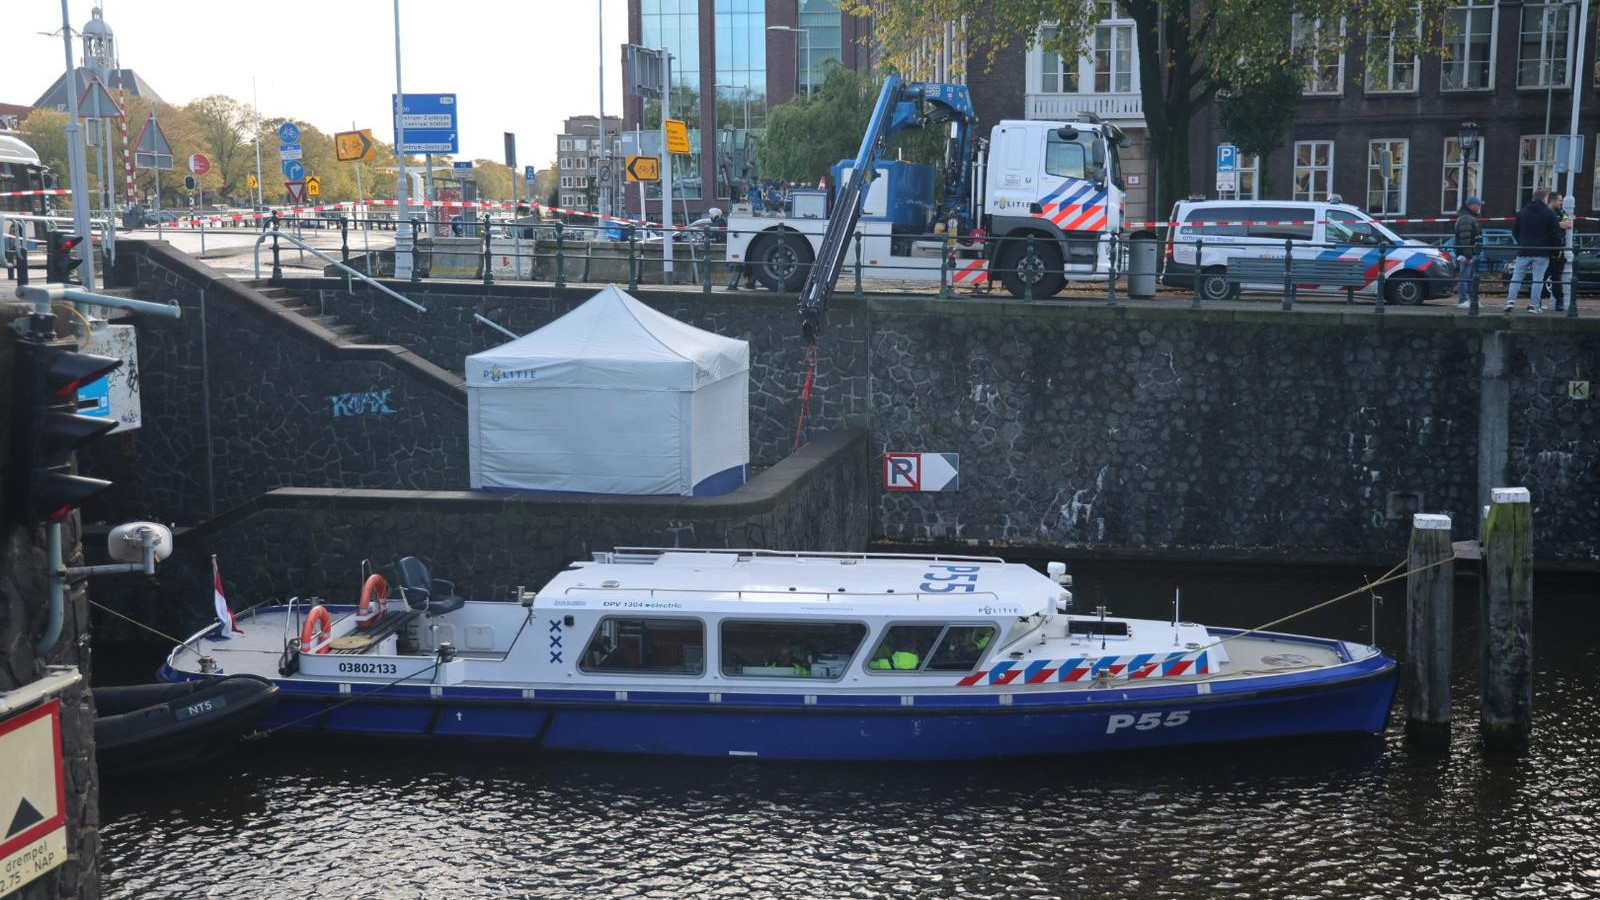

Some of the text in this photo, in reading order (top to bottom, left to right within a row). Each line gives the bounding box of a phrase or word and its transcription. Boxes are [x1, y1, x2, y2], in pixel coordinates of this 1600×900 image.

[1221, 148, 1232, 162] P
[993, 201, 1031, 209] POLITIE
[483, 369, 537, 382] POLITIE
[1573, 382, 1584, 395] K
[919, 565, 981, 593] P55
[978, 605, 1018, 615] POLITIE
[338, 662, 397, 674] 03802133
[1106, 710, 1191, 734] P55
[6, 840, 48, 873] drempel
[34, 852, 54, 873] NAP
